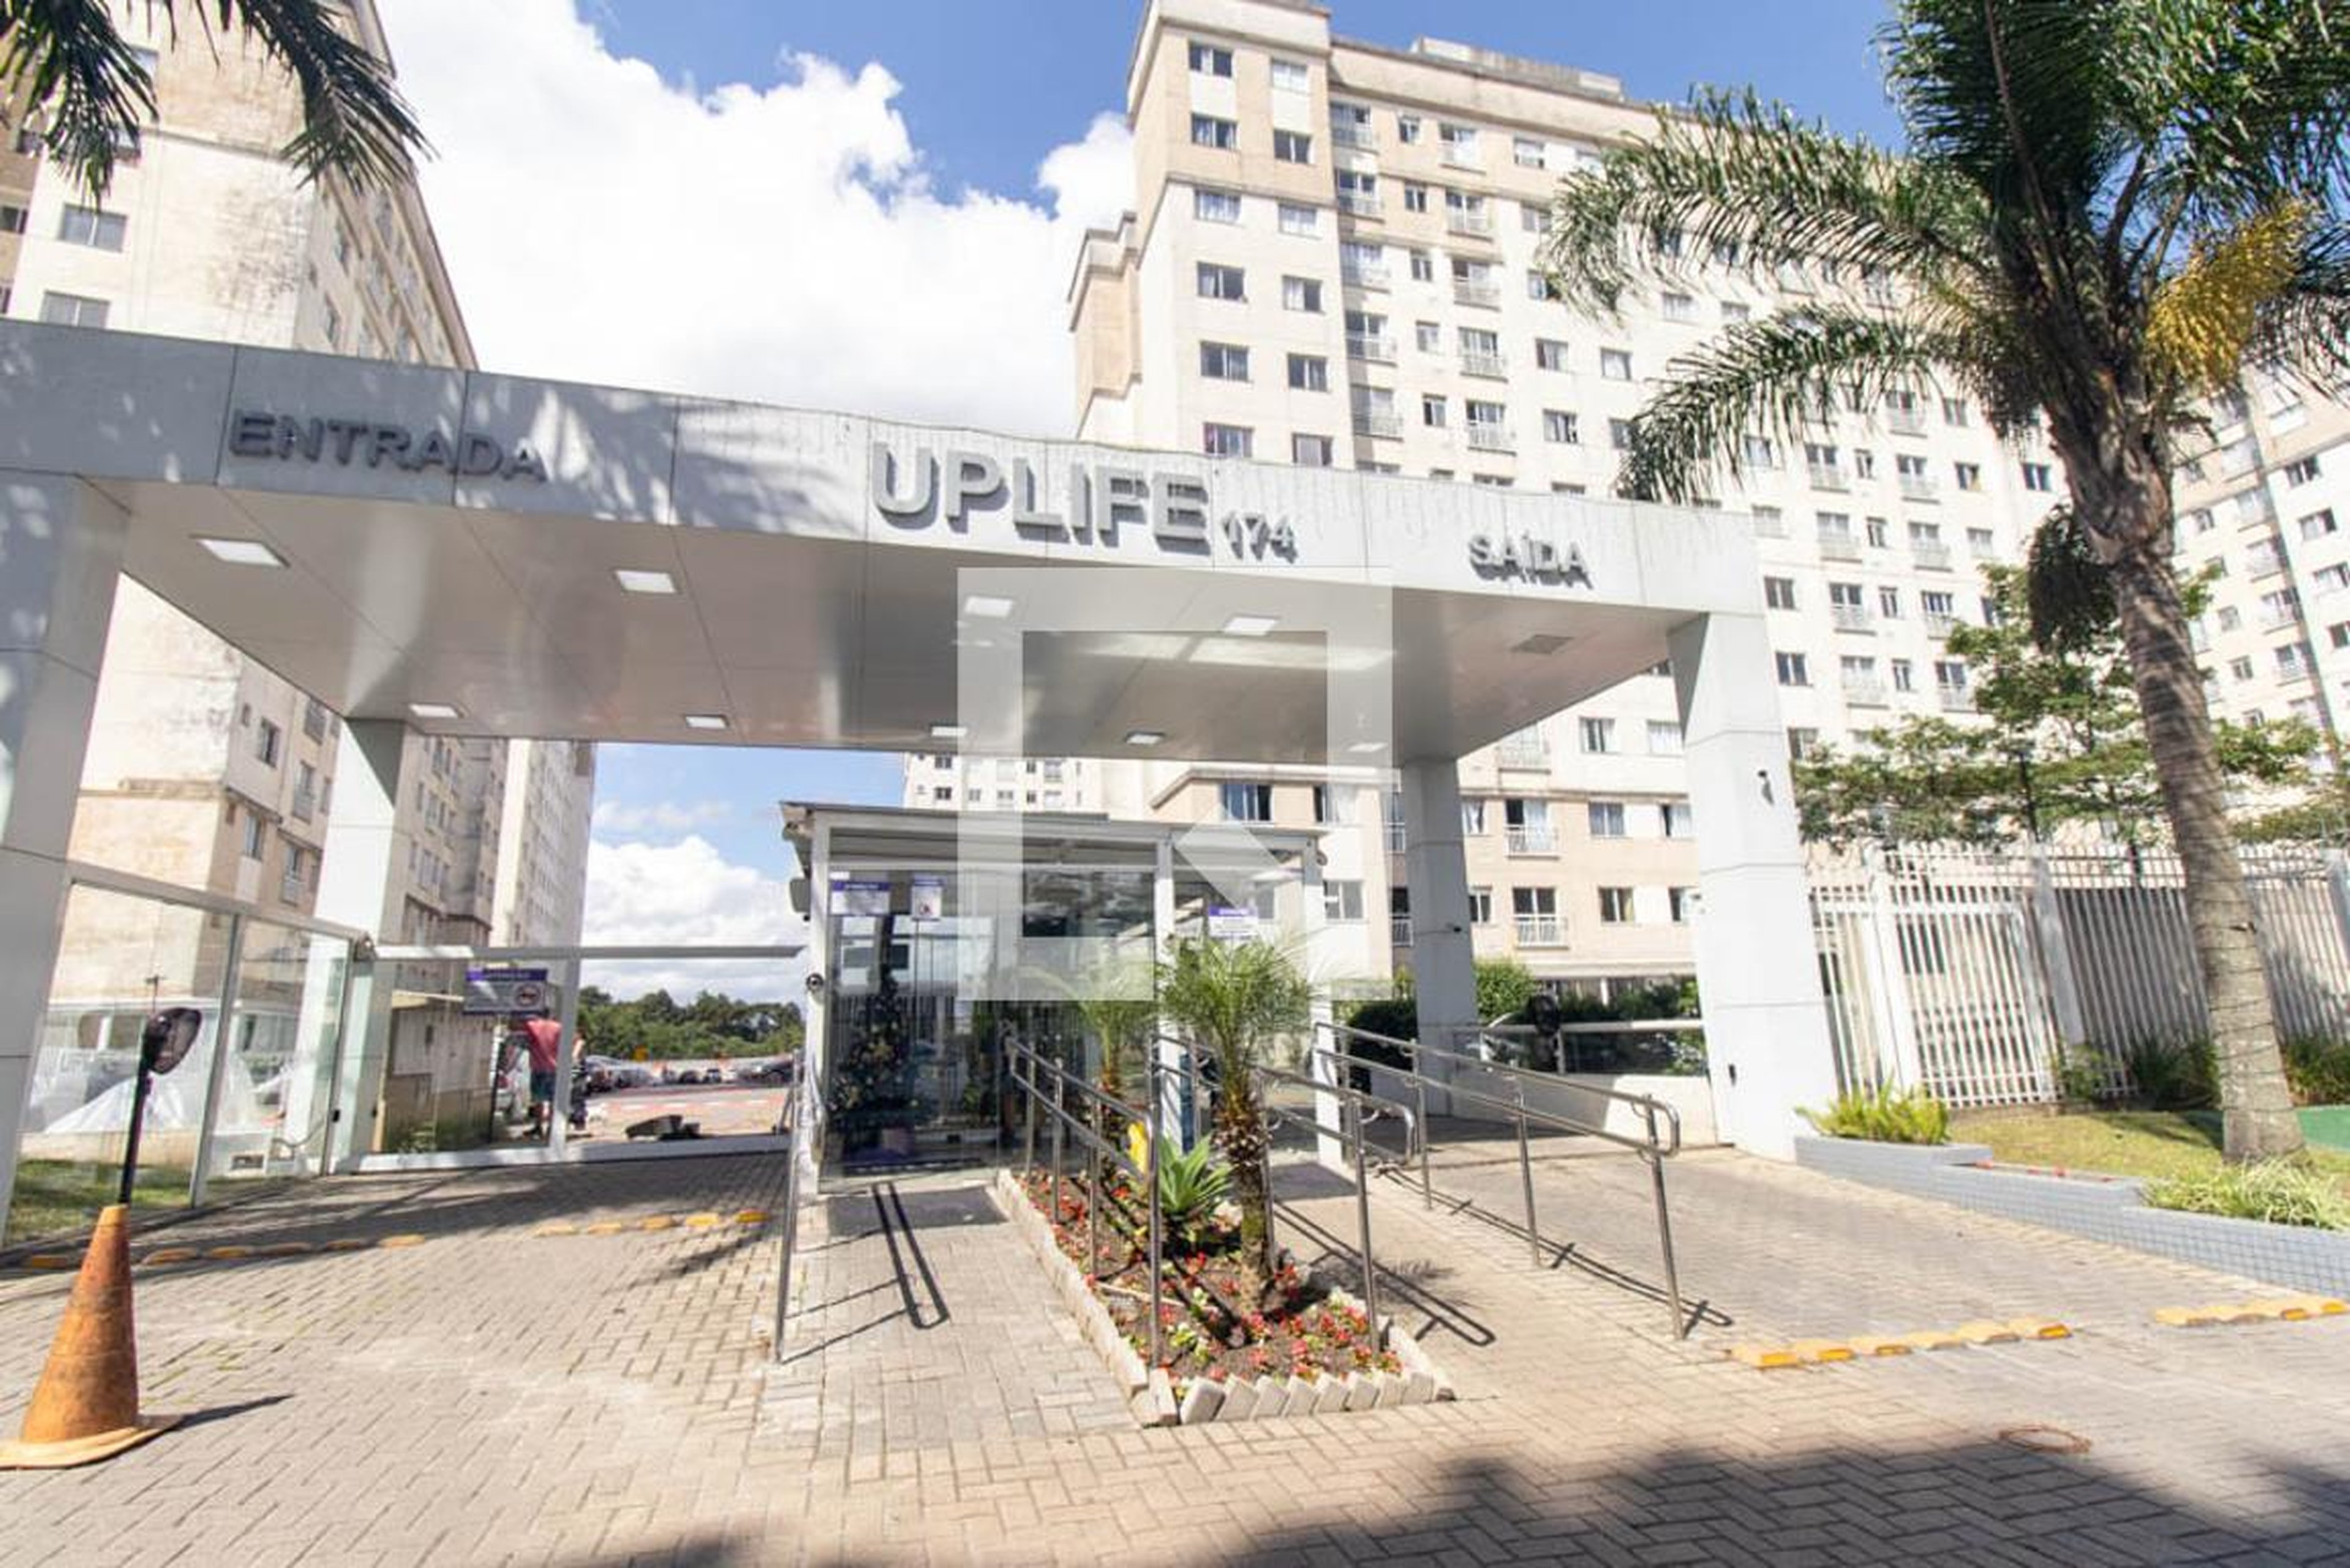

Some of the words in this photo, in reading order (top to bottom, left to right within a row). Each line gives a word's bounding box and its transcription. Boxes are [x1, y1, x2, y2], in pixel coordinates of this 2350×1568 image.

[229, 409, 547, 482] ENTRADA
[873, 441, 1209, 547] UPLIFE
[1223, 512, 1297, 558] 174
[1468, 531, 1591, 579] SAÍDA
